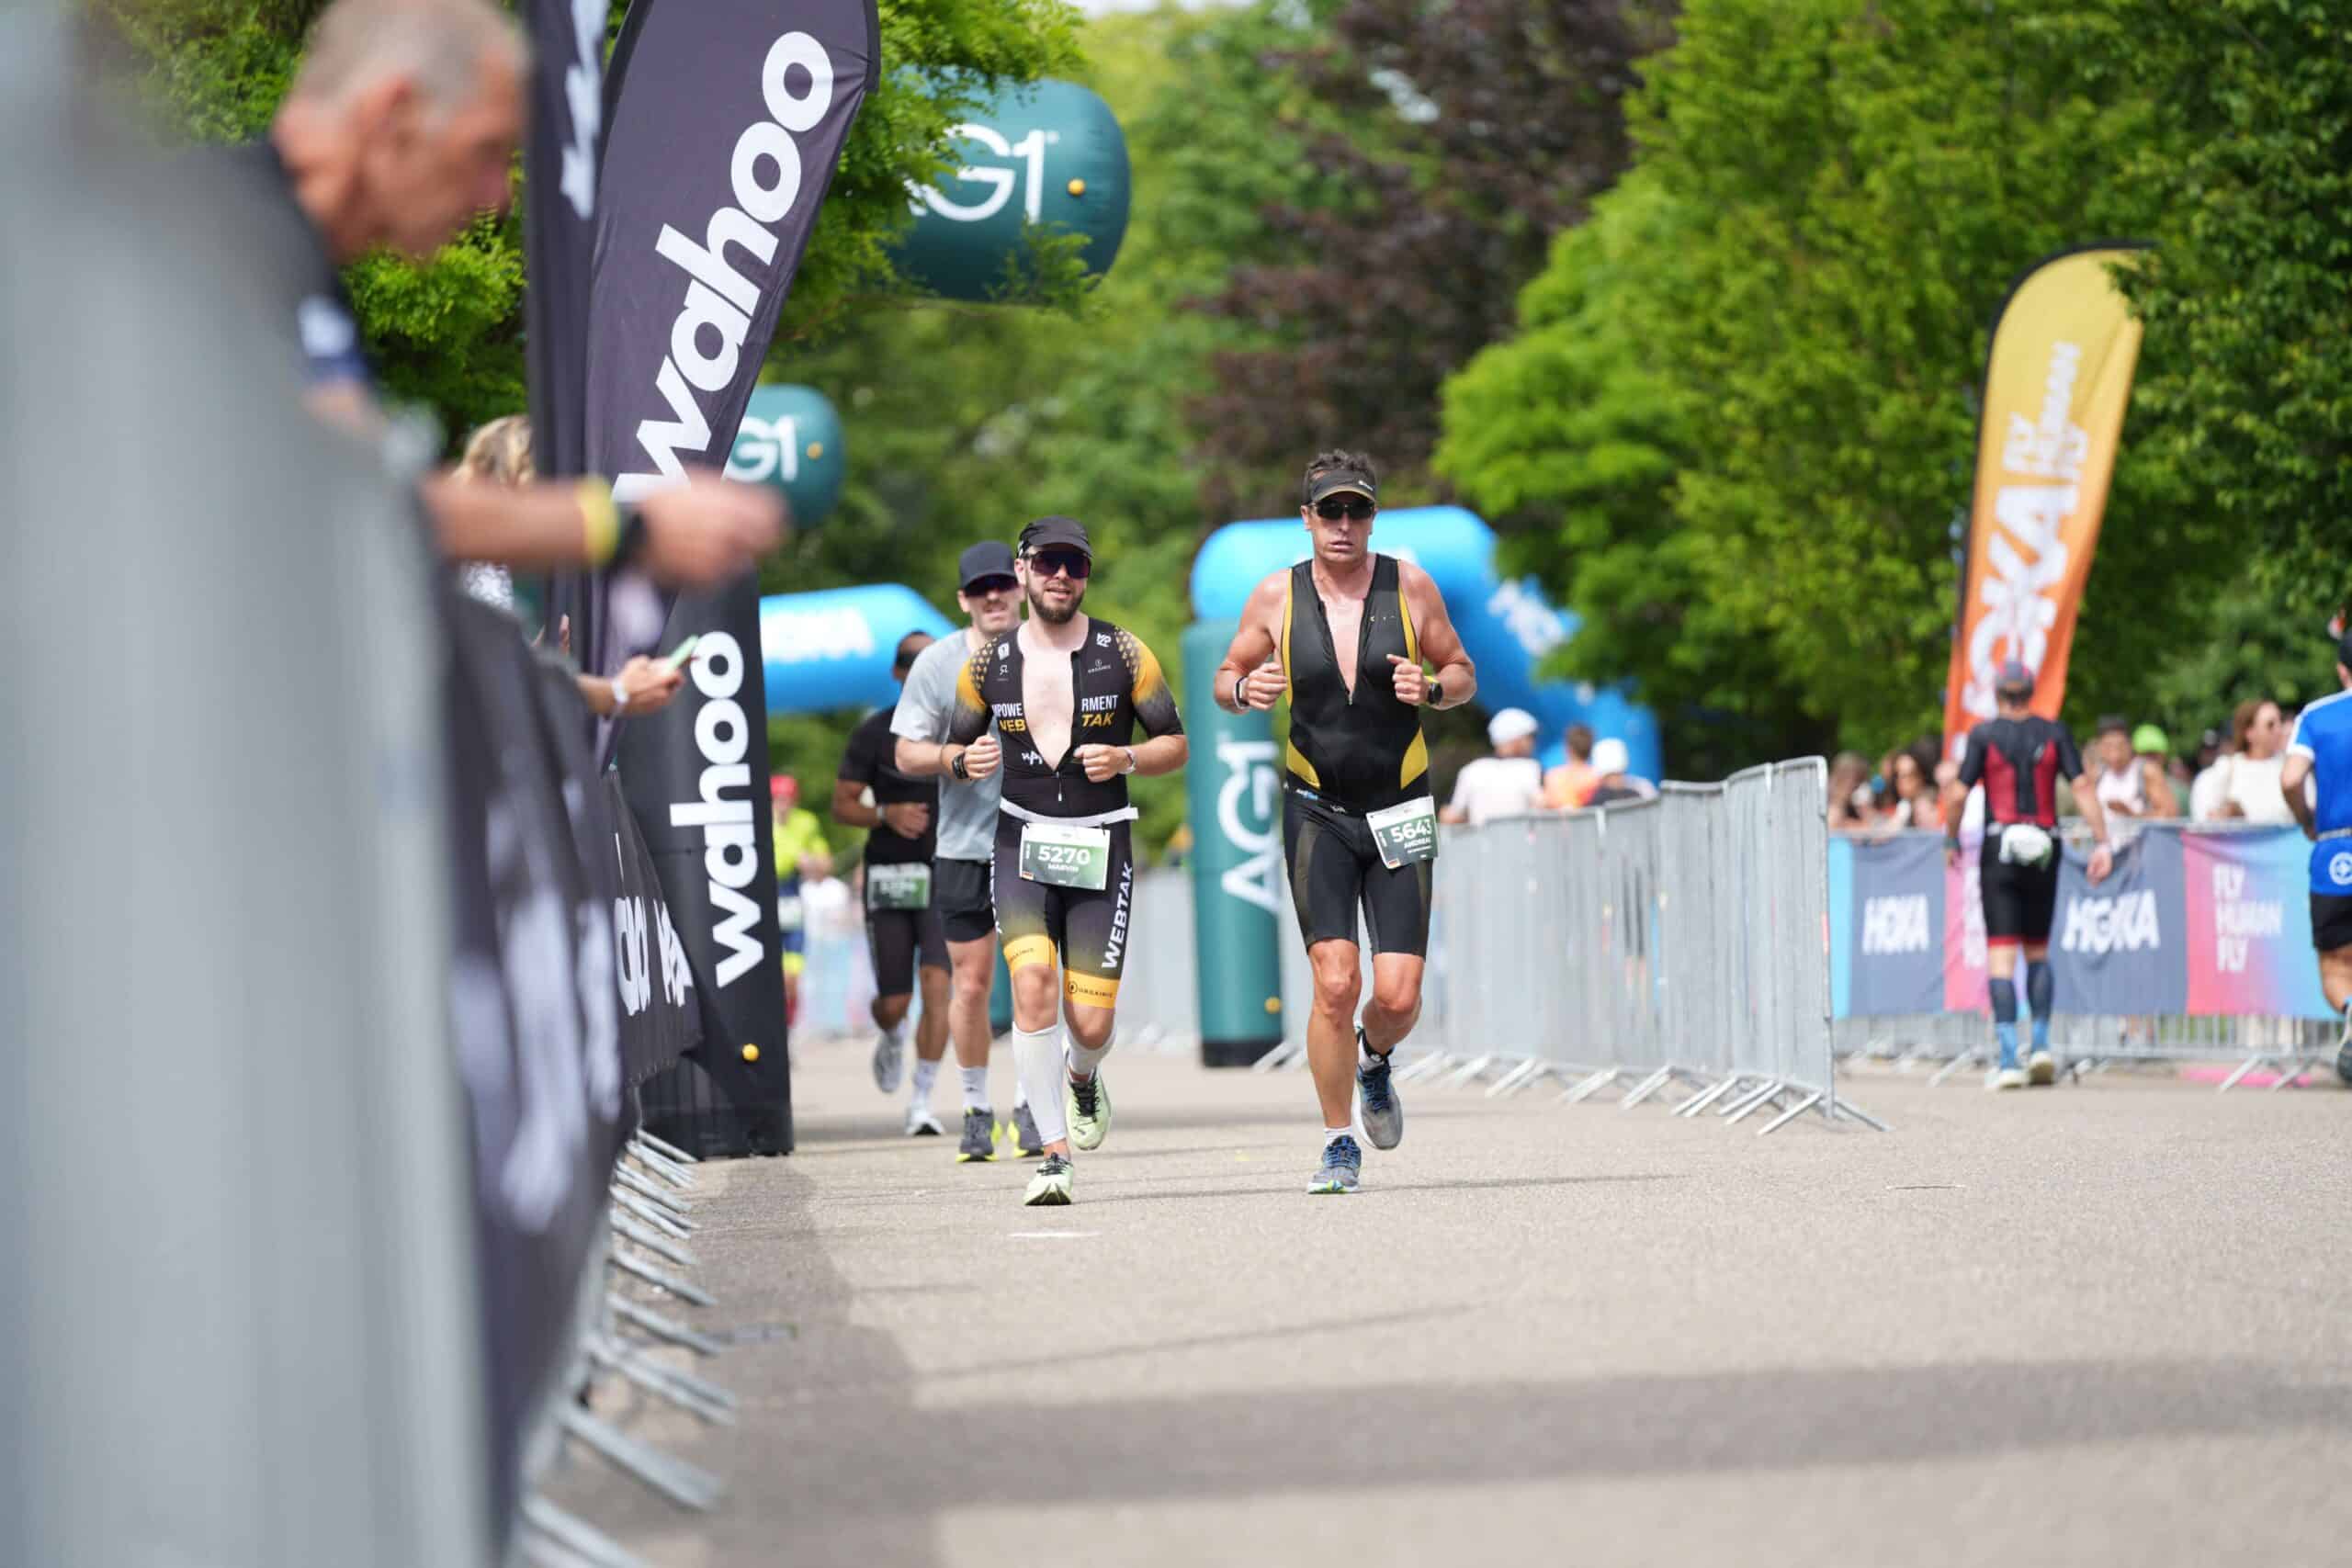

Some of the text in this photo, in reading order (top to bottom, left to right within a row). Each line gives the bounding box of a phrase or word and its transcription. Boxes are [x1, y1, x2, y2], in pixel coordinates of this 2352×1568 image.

[903, 123, 1046, 225] G1
[609, 30, 834, 504] wahoo
[721, 415, 797, 482] G1
[1081, 712, 1114, 728] TAK
[669, 630, 764, 988] wahoo
[1217, 740, 1280, 913] AG1
[1037, 844, 1091, 865] 5270
[1102, 861, 1133, 969] WEBTAK
[1861, 894, 1929, 955] HOKA
[2061, 889, 2161, 953] HOKA
